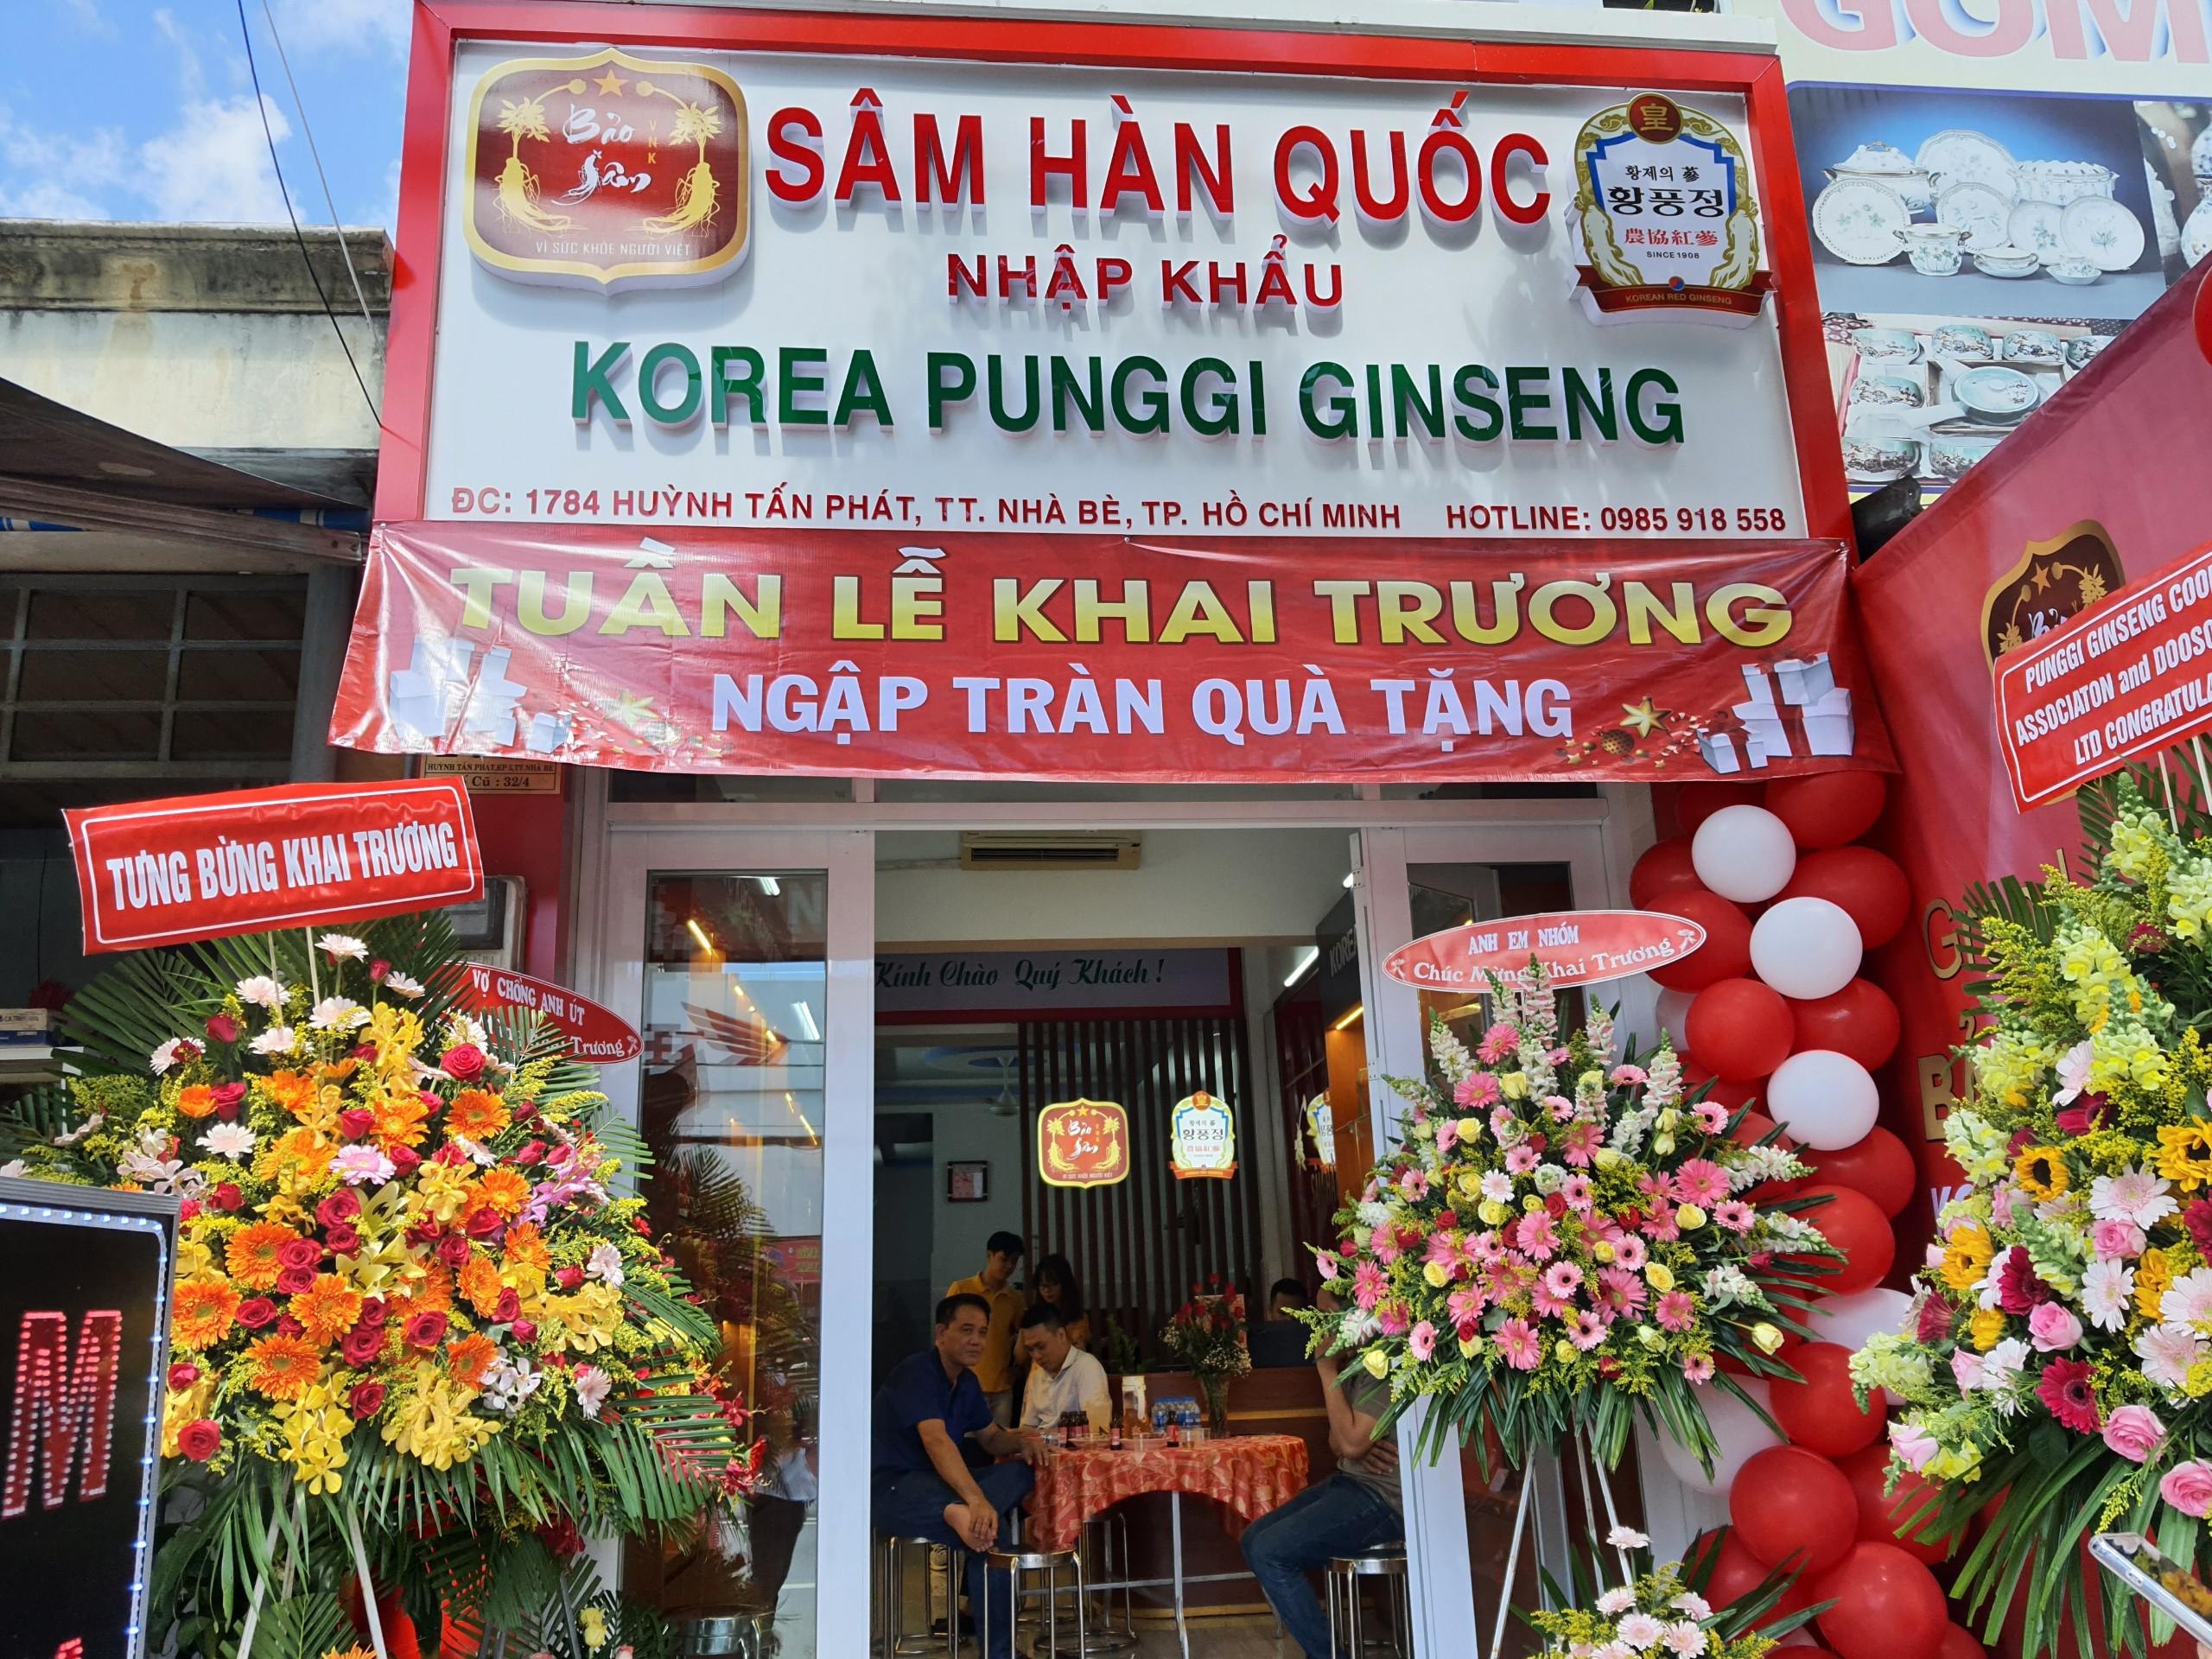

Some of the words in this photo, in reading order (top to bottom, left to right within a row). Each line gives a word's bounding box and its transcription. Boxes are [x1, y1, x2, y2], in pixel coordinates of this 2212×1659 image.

[562, 103, 636, 145] Bảo
[1639, 103, 1675, 132] 皇
[765, 86, 986, 209] SÂM
[1029, 93, 1235, 218] HÀN
[1273, 90, 1552, 226] QUỐC
[1625, 165, 1674, 181] 황제의
[1607, 186, 1725, 218] 황풍정
[536, 241, 548, 252] VÌ
[552, 241, 579, 254] SỨC
[1646, 251, 1675, 259] SINCE
[947, 244, 1134, 313] NHẬP
[1160, 234, 1343, 308] KHẨU
[1625, 294, 1665, 304] KOREAN
[1667, 293, 1687, 302] RED
[1688, 294, 1732, 305] GINSENG
[571, 340, 893, 431] KOREA
[927, 352, 1268, 440] PUNGGI
[1298, 361, 1685, 448] GINSENG
[451, 486, 512, 514] ĐC:
[525, 489, 601, 516] 1784
[613, 484, 733, 518] HUỲNH
[745, 482, 813, 519] TẤN
[825, 487, 921, 526] PHÁT,
[935, 497, 984, 522] TT.
[998, 493, 1066, 524] NHÀ
[1077, 494, 1134, 529] BÈ,
[1141, 500, 1187, 526] TP.
[1202, 489, 1249, 526] HỒ
[1258, 497, 1313, 528] CHÍ
[1322, 503, 1402, 529] MINH
[1446, 505, 1591, 531] HOTLINE:
[1600, 507, 1669, 531] 0985
[1676, 507, 1727, 531] 918
[1737, 507, 1787, 531] 558
[448, 537, 782, 639] TUẦN
[832, 545, 948, 642] LỄ
[992, 576, 1277, 645] KHAI
[1313, 570, 1794, 647] TRƯƠNG
[2024, 639, 2084, 694] PUNGGI
[2087, 593, 2167, 659] GINSENG
[2168, 565, 2212, 613] COO
[714, 660, 929, 745] NGẬP
[953, 662, 1166, 735] TRÀN
[1191, 664, 1348, 747] QUÀ
[1370, 667, 1573, 753] TẶNG
[2014, 673, 2115, 747] ASSOCIATON
[2118, 653, 2152, 695] and
[2074, 728, 2102, 766] LTD
[472, 774, 490, 786] Cũ
[504, 776, 530, 787] 32/4
[106, 849, 191, 911] TƯNG
[197, 836, 279, 899] BỪNG
[283, 833, 352, 888] KHAI
[353, 821, 459, 879] TRƯƠNG
[1467, 932, 1498, 955] ANH
[1508, 930, 1529, 950] EM
[1537, 920, 1580, 948] NHÓM
[875, 959, 931, 988] Kính
[939, 959, 1000, 988] Chào
[1014, 958, 1062, 991] Quý
[1068, 957, 1148, 987] Khách
[1413, 959, 1464, 983] Chúc
[1591, 938, 1675, 970] Trương
[473, 969, 491, 997] VỢ
[497, 976, 536, 1007] CHỒNG
[541, 992, 564, 1018] ANH
[569, 997, 586, 1026] ÚT
[569, 1035, 626, 1057] Trương
